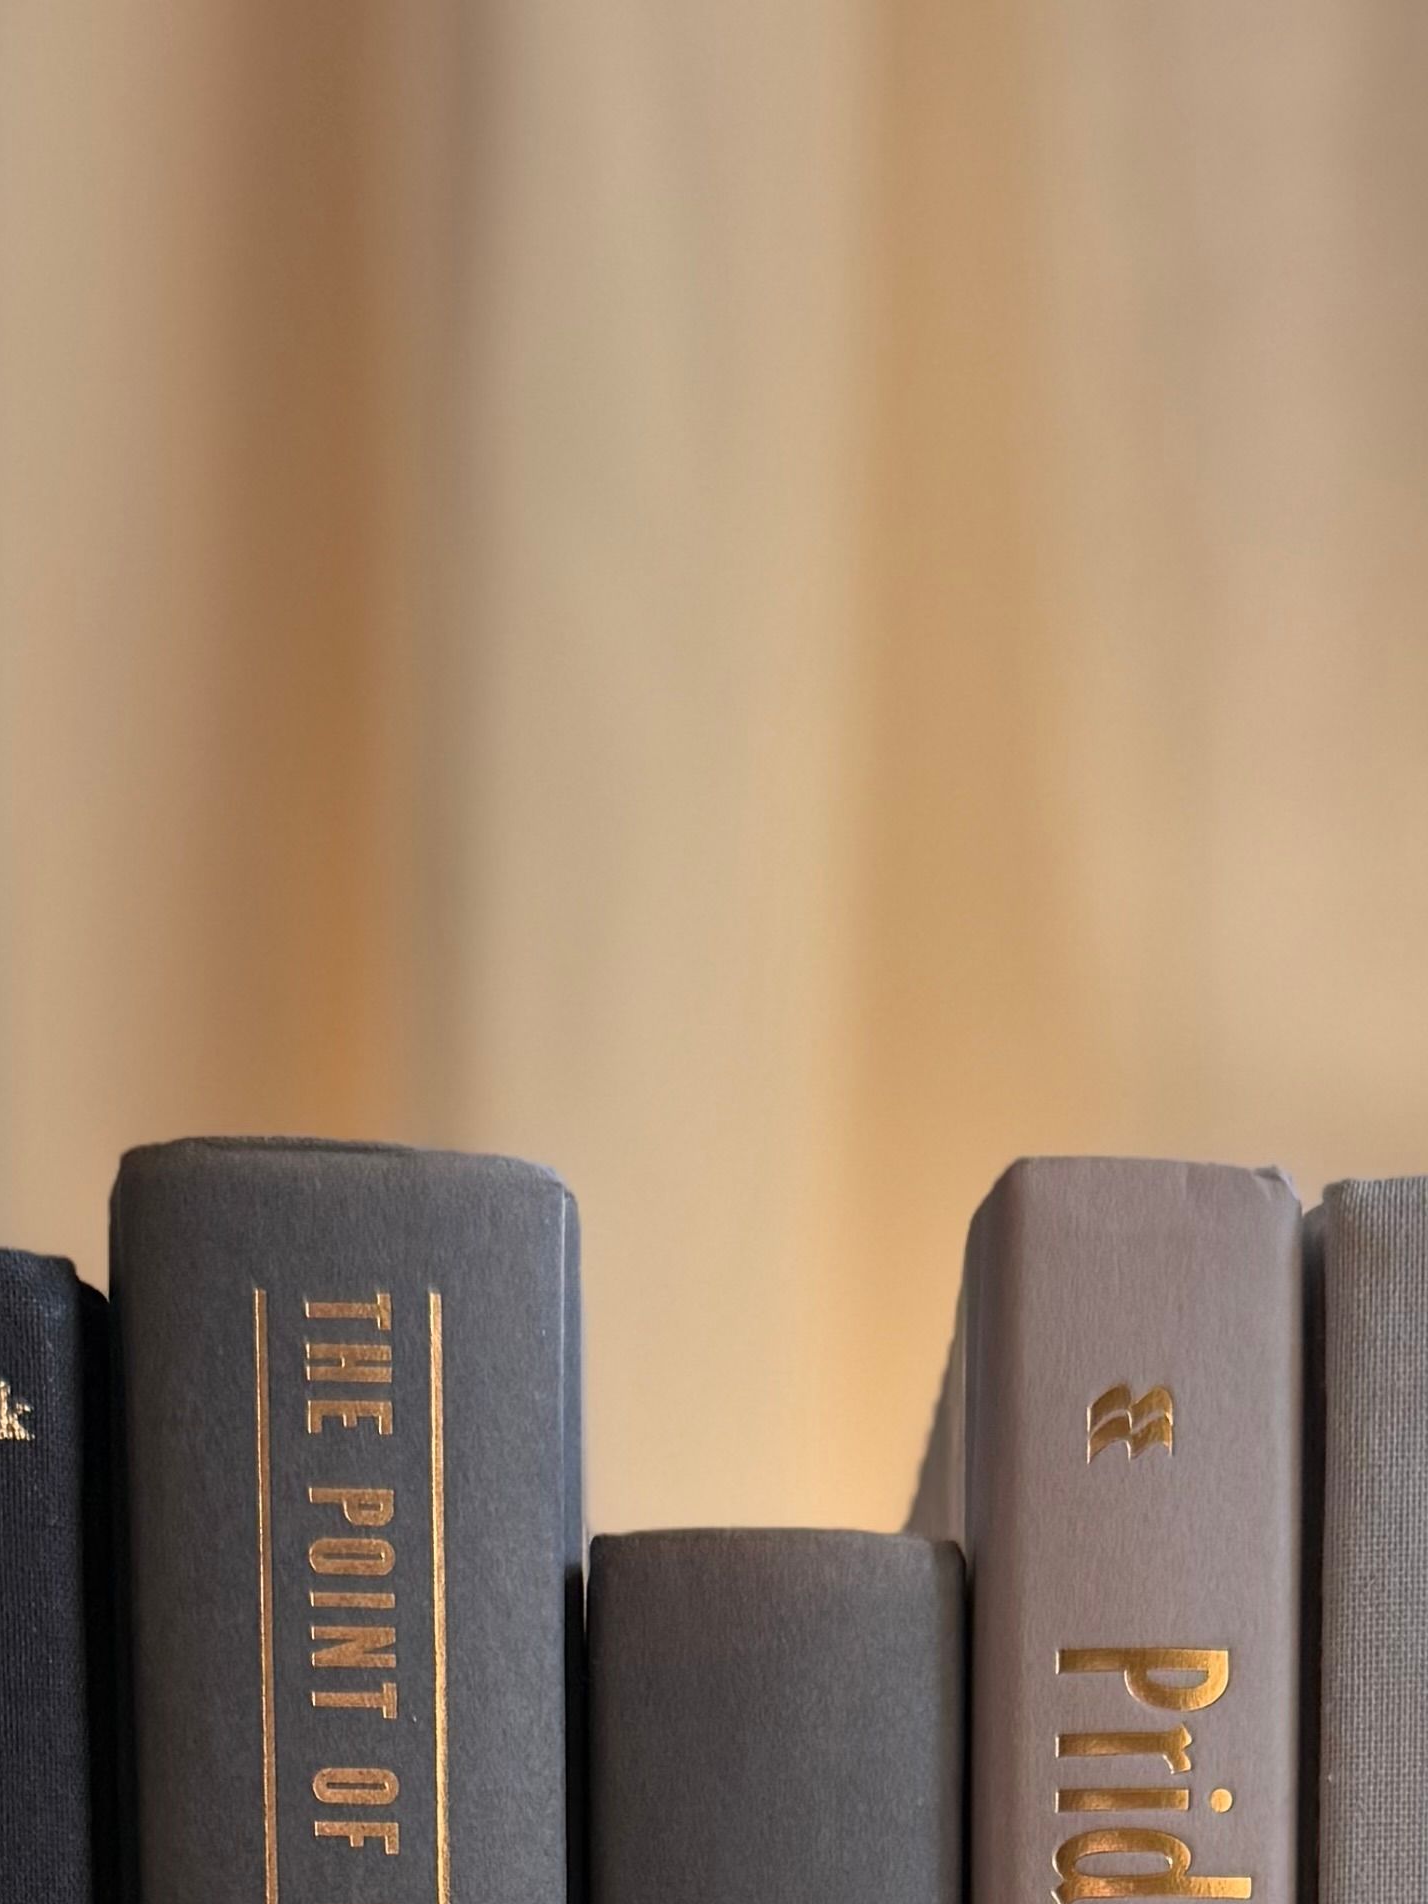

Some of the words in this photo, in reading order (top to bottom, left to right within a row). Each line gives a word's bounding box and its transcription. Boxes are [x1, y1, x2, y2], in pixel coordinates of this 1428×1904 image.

[305, 1291, 393, 1437] THE
[307, 1487, 398, 1721] POINT
[312, 1767, 400, 1857] OF
